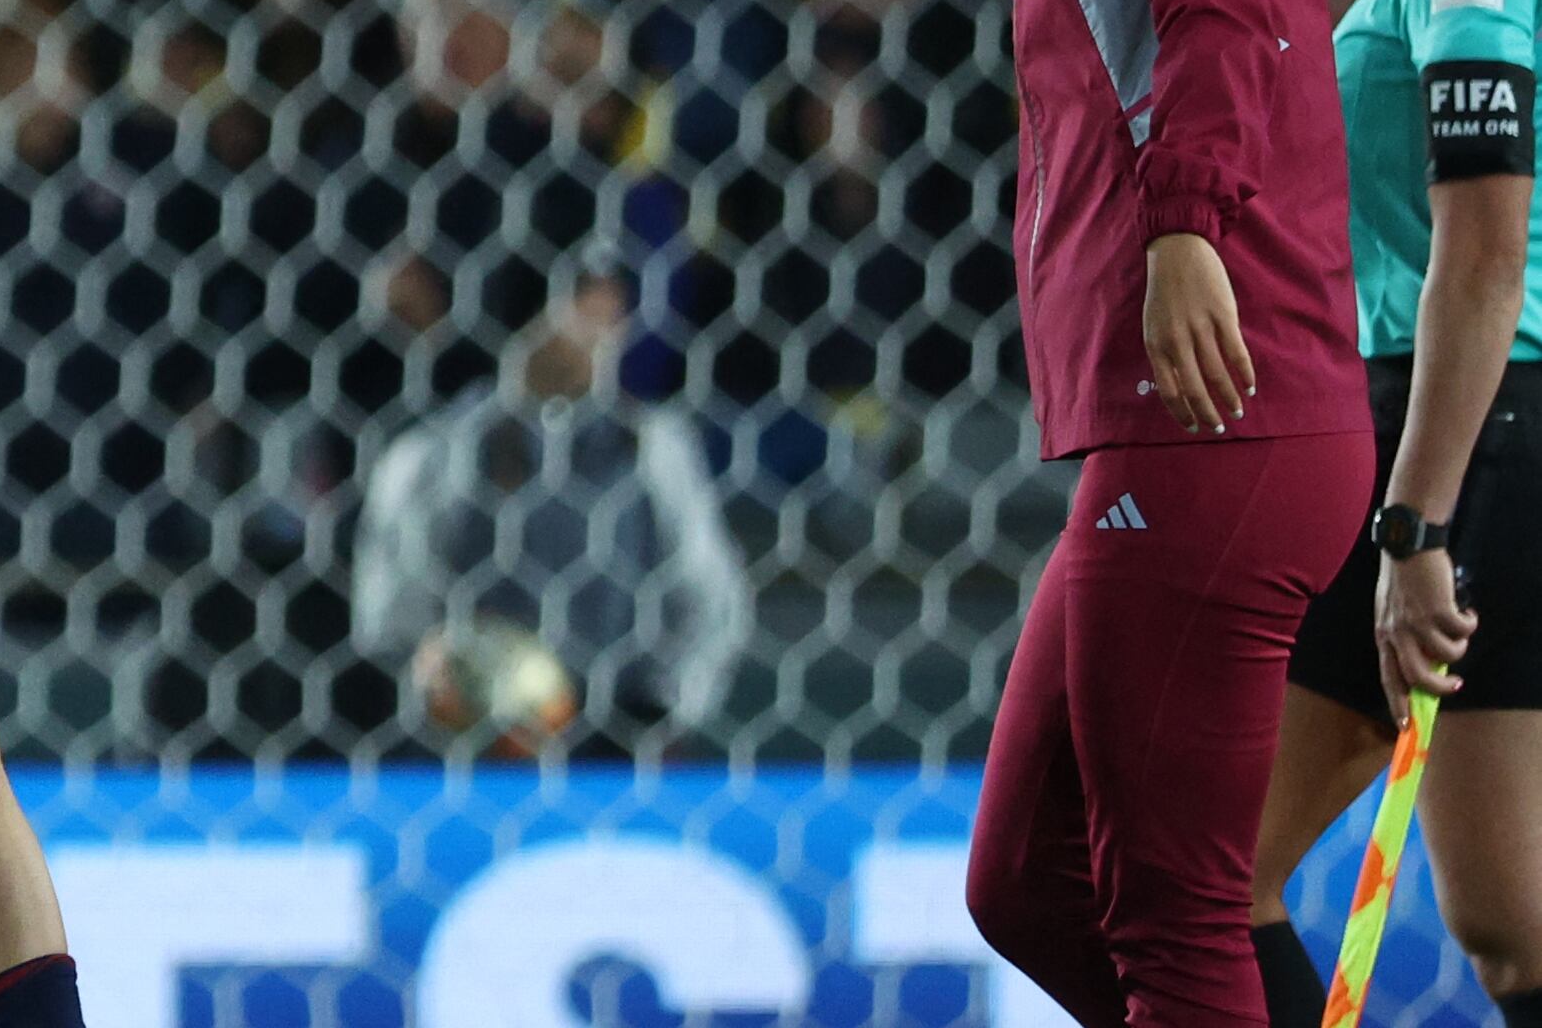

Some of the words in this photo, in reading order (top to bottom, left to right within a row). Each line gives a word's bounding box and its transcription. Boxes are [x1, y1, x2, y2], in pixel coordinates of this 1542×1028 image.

[1430, 78, 1518, 113] FIFA
[1432, 119, 1480, 137] TEAM
[1484, 119, 1520, 137] ONE
